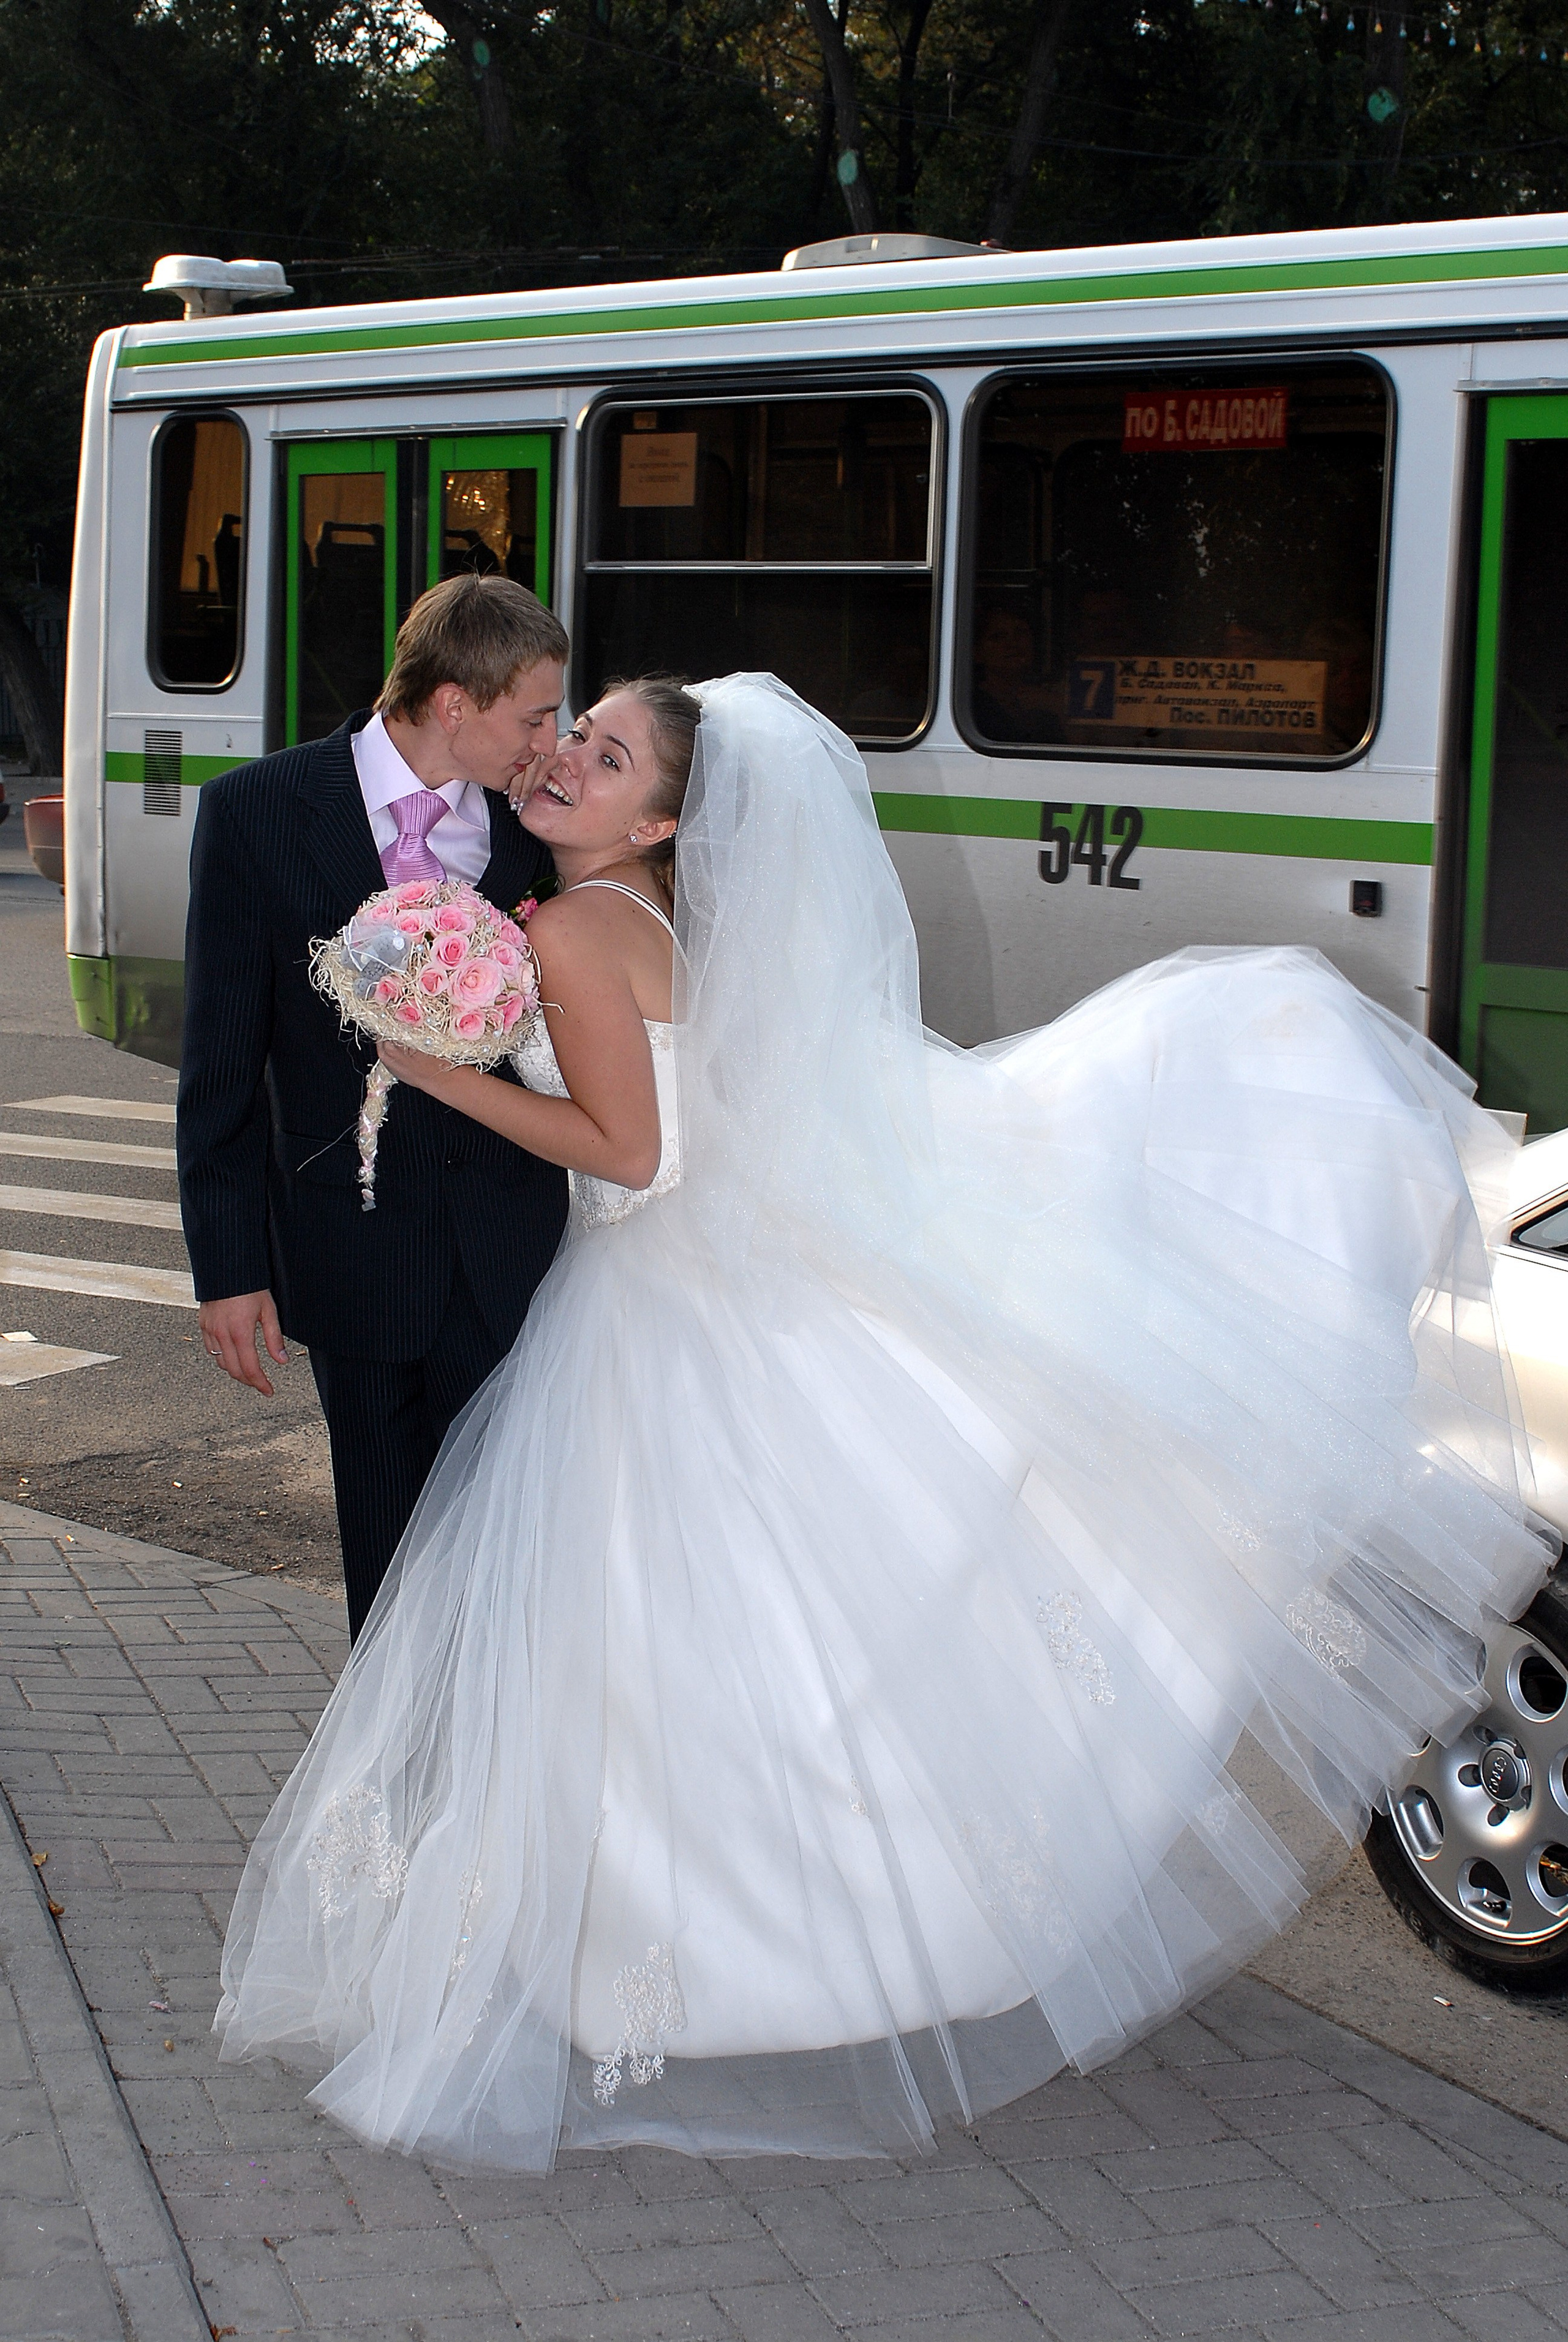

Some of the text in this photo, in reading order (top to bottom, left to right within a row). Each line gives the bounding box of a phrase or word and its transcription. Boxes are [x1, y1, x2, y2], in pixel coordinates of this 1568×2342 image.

[1186, 391, 1286, 444] САДОВОЙ
[1079, 669, 1104, 710] 7
[1173, 661, 1255, 679] ВОКЗАЛ
[1170, 707, 1316, 728] Пос. ПИЛОТОВ
[1038, 801, 1144, 890] 542
